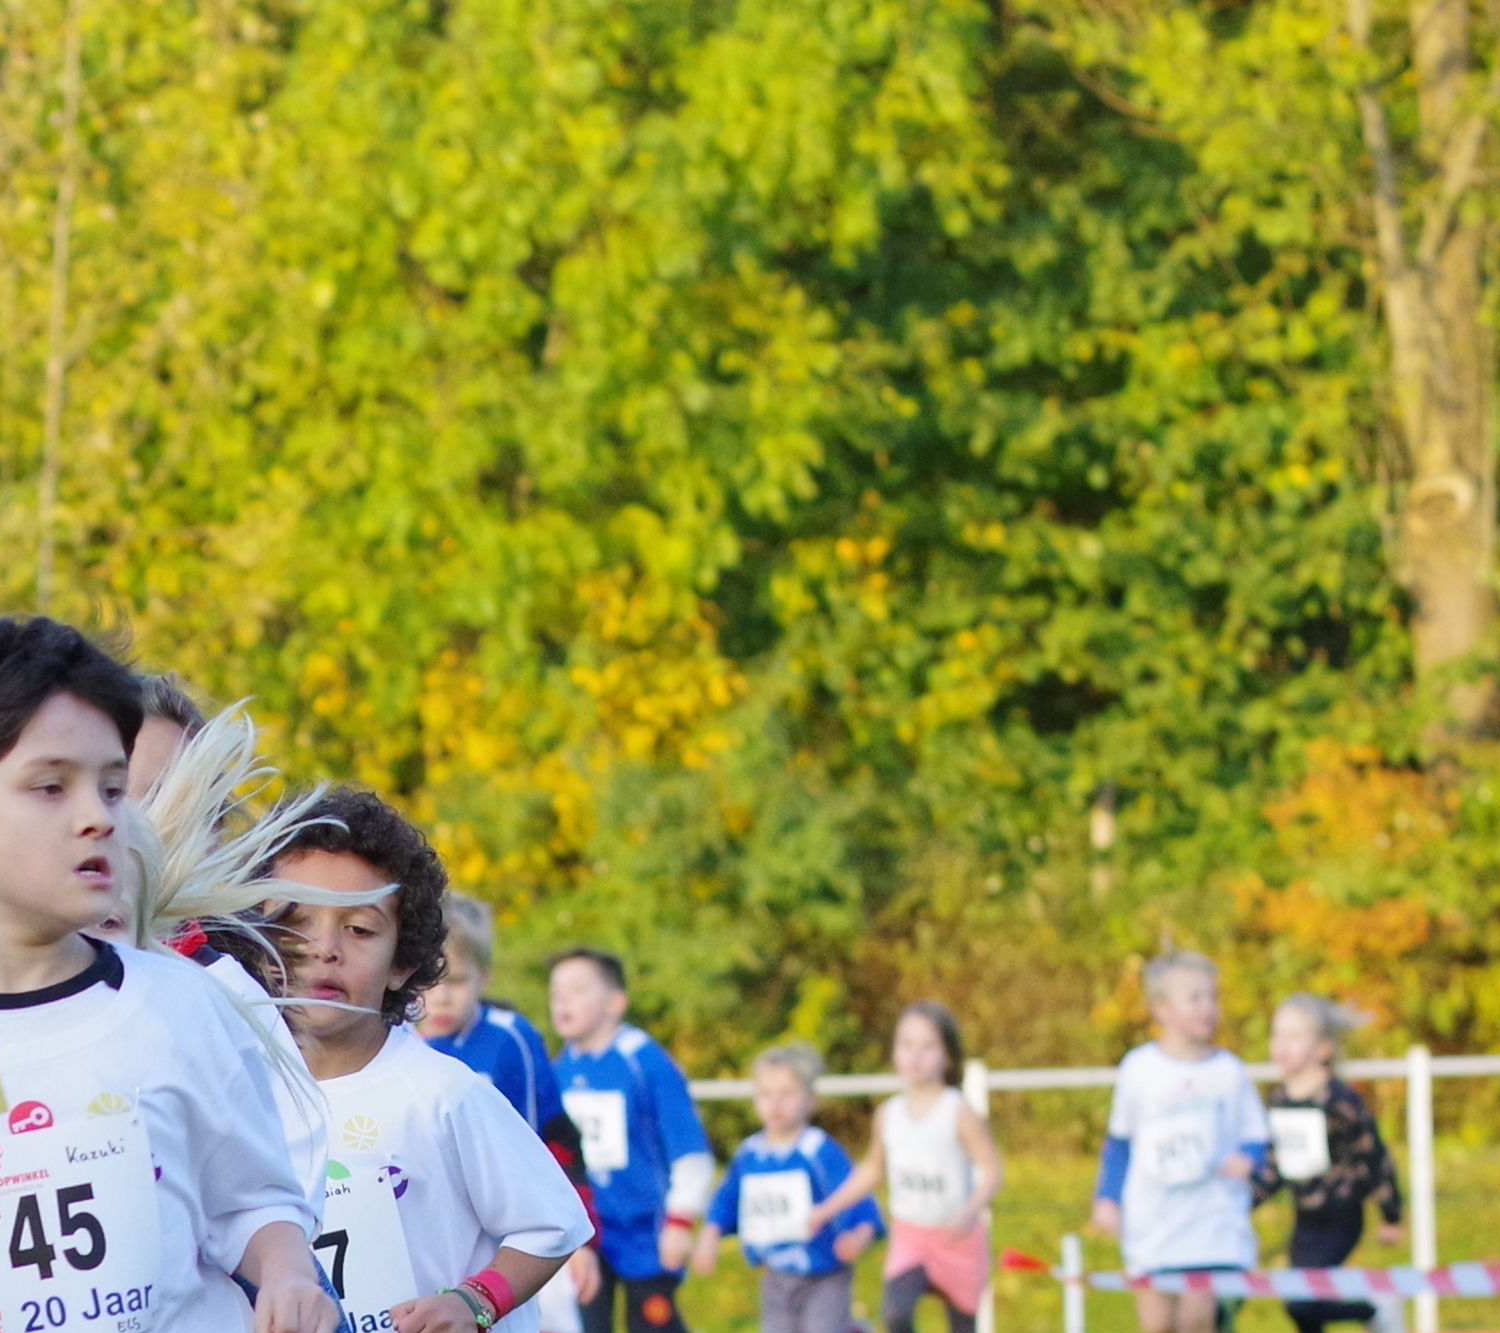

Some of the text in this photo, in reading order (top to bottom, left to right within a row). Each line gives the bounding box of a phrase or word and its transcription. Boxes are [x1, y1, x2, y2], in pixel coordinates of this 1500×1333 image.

[65, 1137, 126, 1164] Kazuki
[20, 1284, 153, 1333] 20 Jaar
